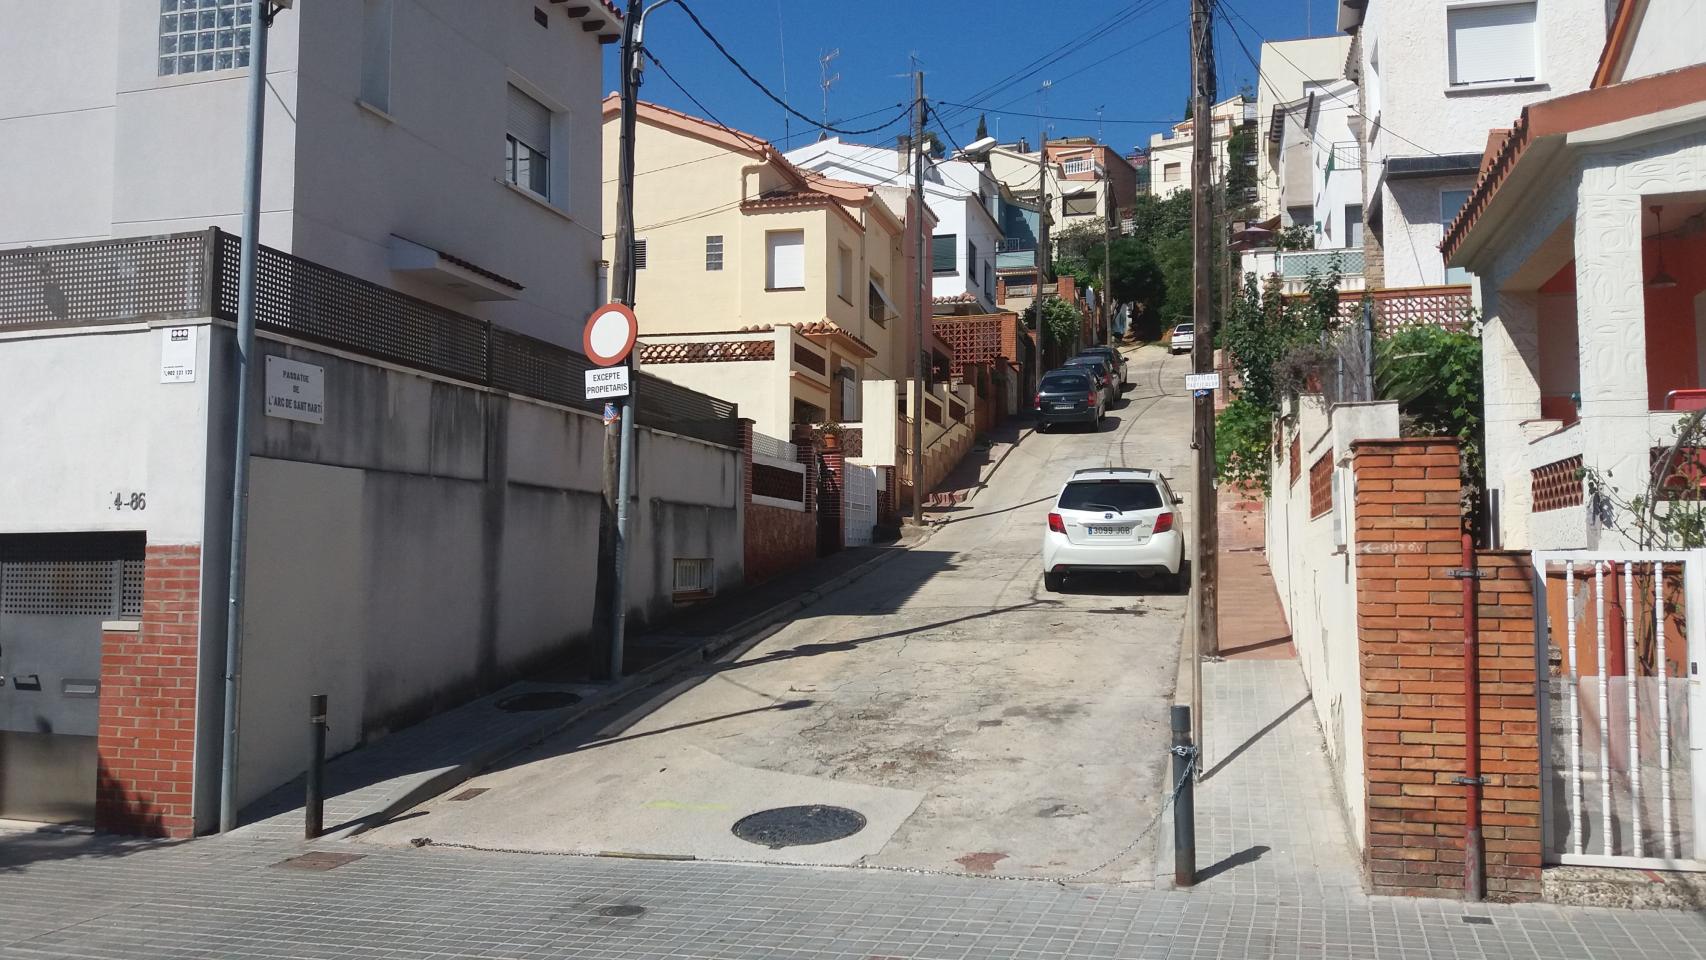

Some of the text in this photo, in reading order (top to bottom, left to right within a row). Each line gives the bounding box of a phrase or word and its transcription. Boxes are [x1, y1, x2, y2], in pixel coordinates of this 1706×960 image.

[593, 371, 621, 382] EXCEPTE
[292, 385, 300, 394] DE
[586, 382, 628, 395] PROPIETARIS
[285, 398, 293, 409] DE
[1093, 526, 1113, 535] 3099
